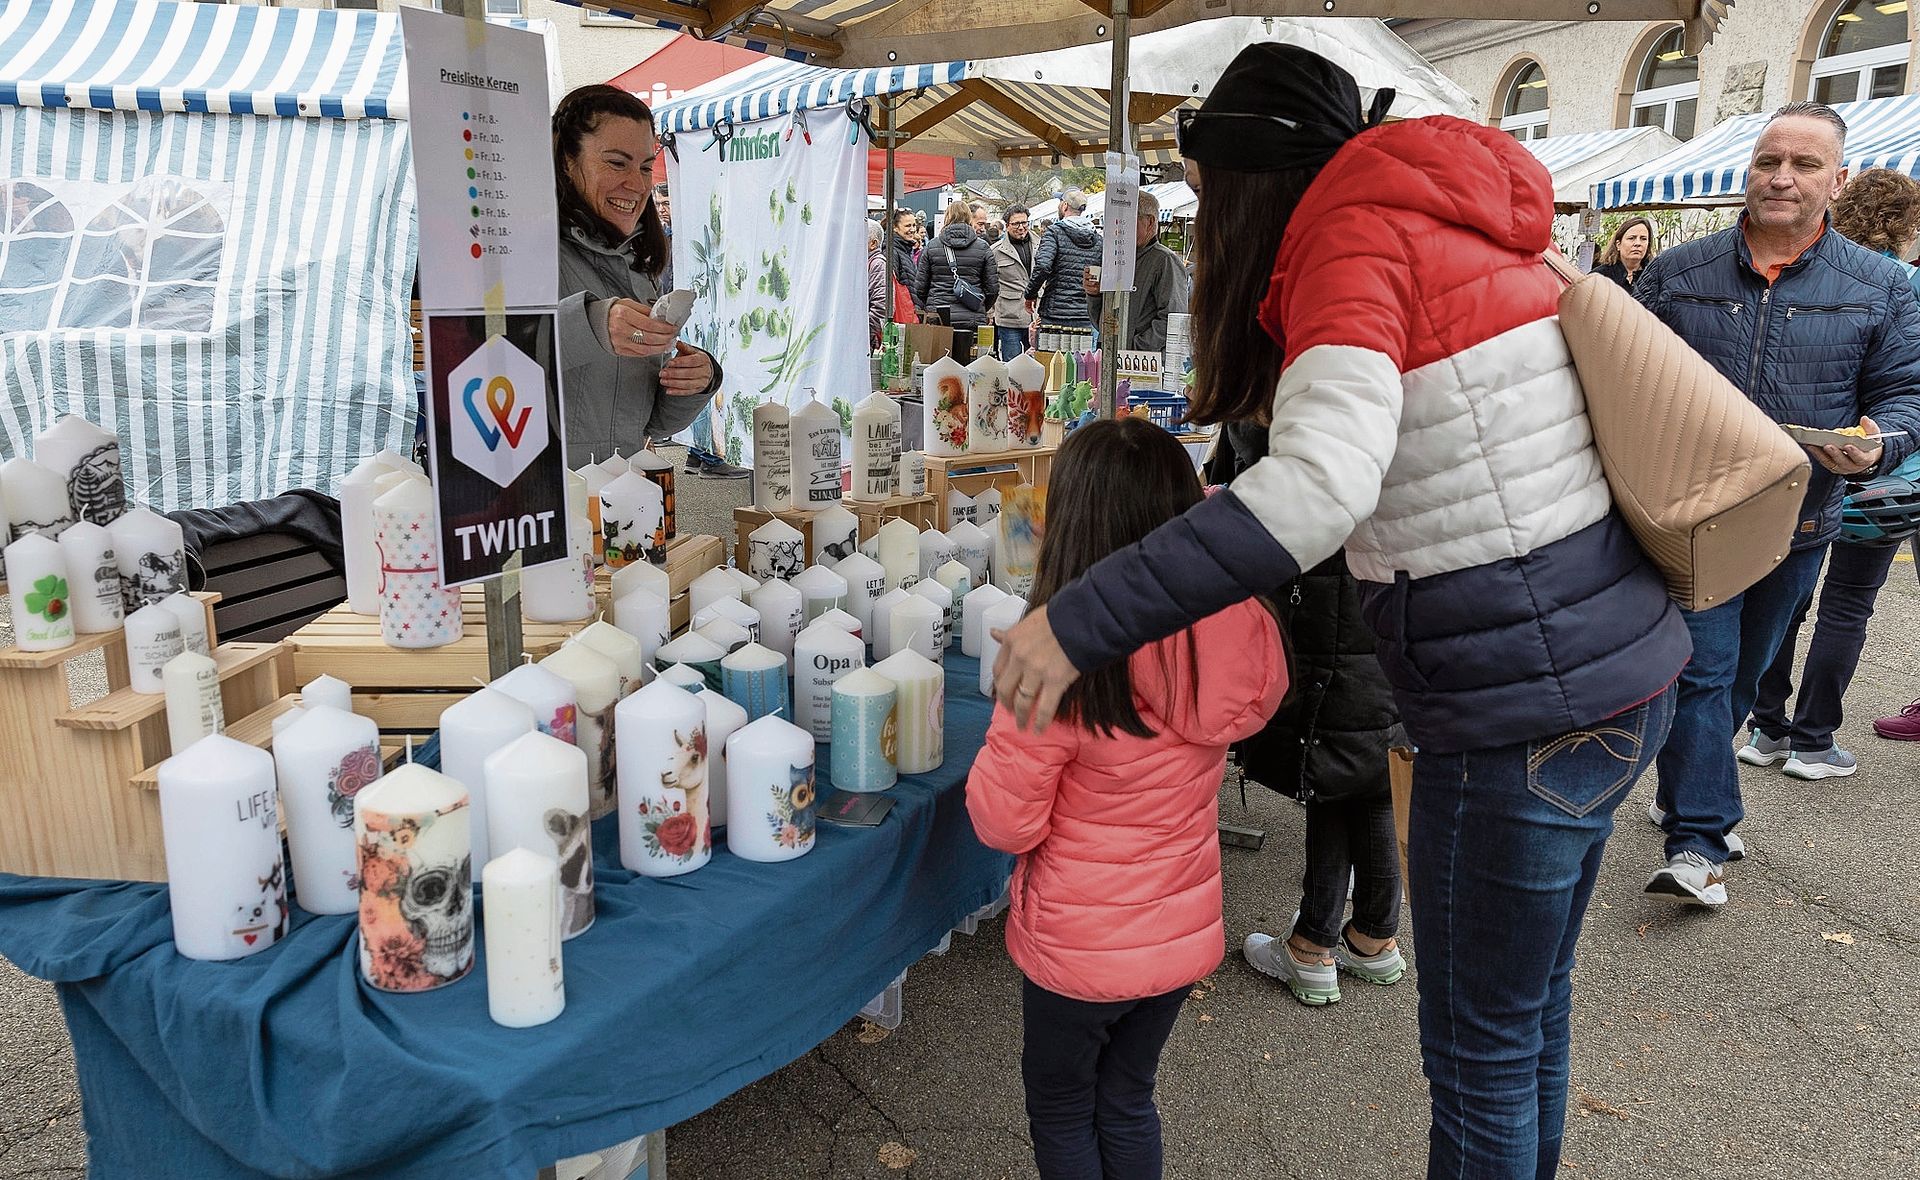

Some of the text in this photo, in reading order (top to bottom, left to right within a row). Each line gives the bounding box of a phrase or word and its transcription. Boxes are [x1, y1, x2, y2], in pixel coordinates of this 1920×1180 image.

[440, 68, 519, 92] Preisliste Kerzen
[478, 113, 488, 122] Fr.
[479, 132, 489, 142] Fr.
[480, 152, 490, 161] Fr.
[482, 170, 492, 180] Fr.
[484, 189, 494, 199] Fr.
[486, 208, 496, 217] Fr.
[487, 227, 497, 236] Fr.
[488, 245, 498, 254] Fr.
[455, 510, 555, 561] TWINT
[866, 580, 877, 589] LET
[813, 654, 850, 674] Opa
[237, 790, 268, 822] LIFE
